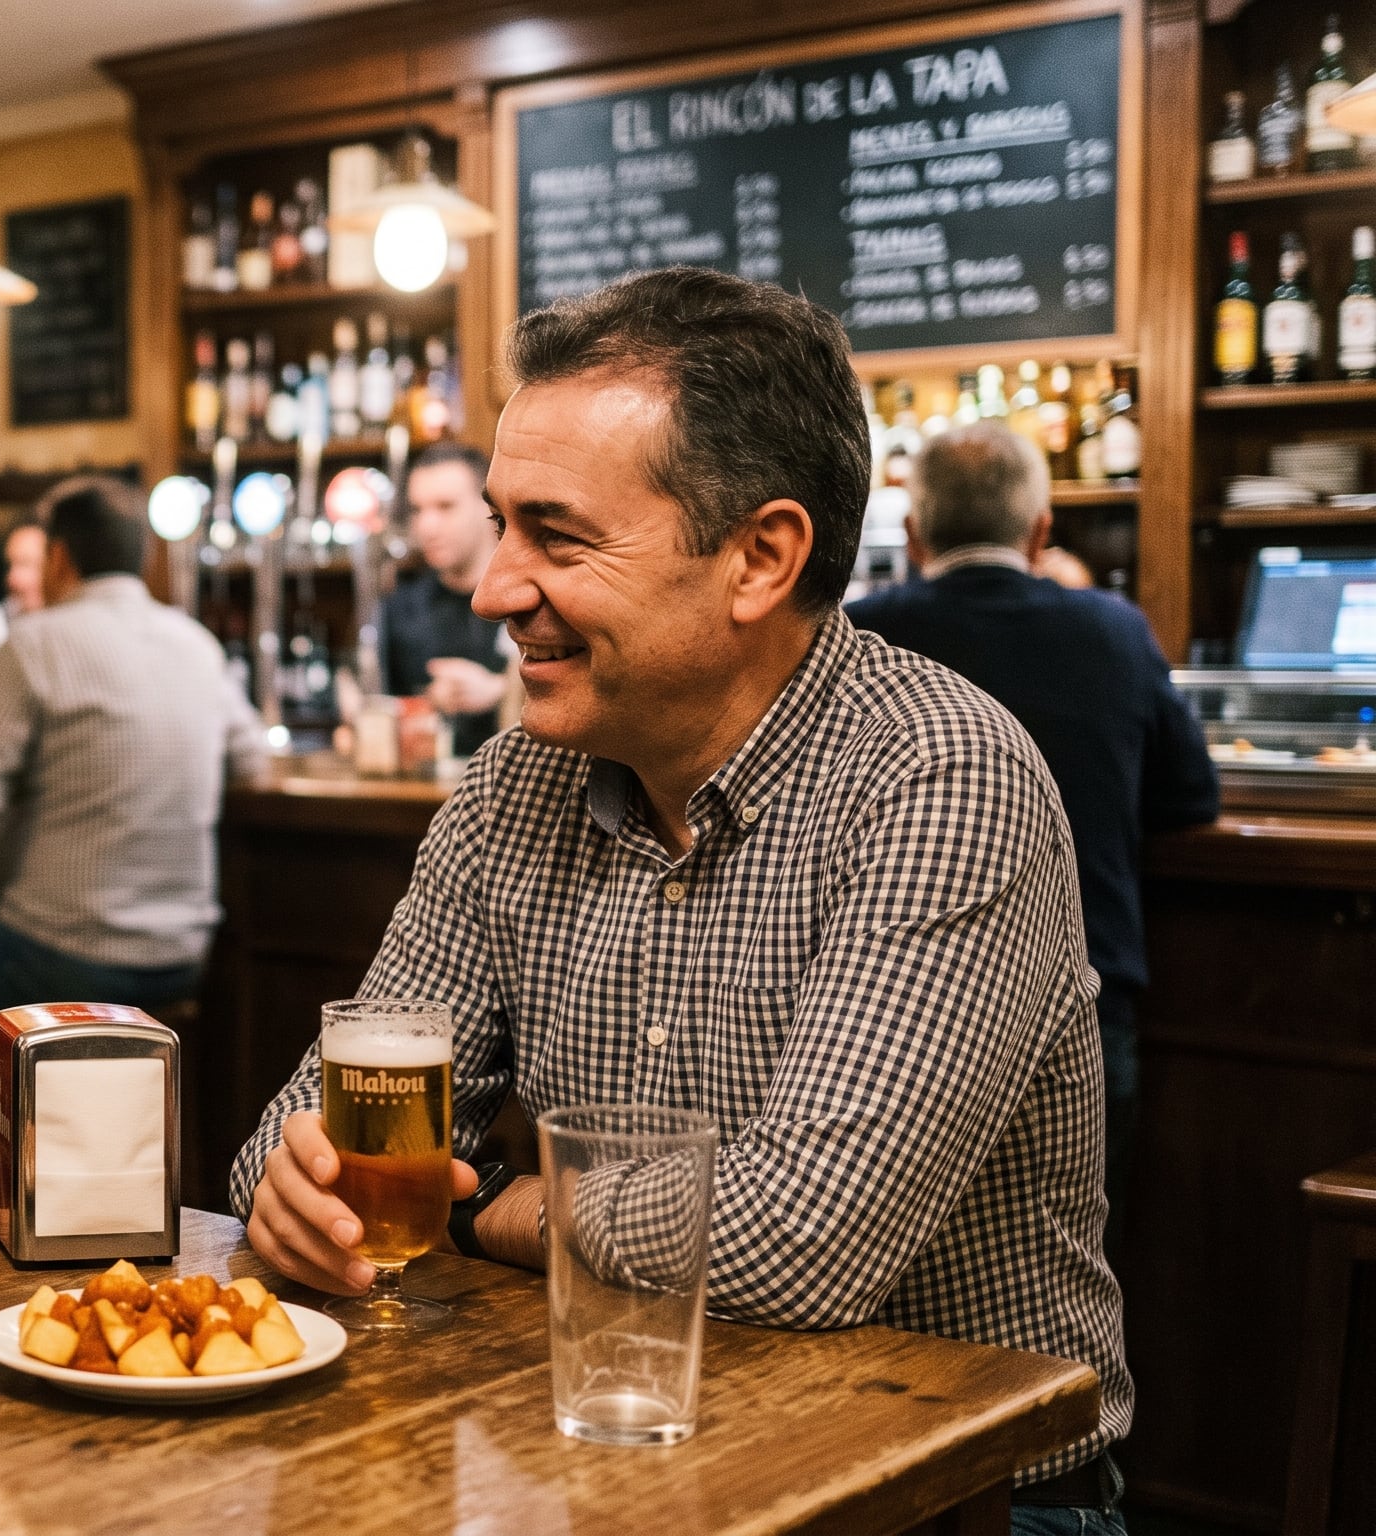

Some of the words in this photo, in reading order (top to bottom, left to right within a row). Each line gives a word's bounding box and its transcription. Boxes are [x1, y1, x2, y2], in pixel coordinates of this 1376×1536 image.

[612, 100, 660, 152] EL
[668, 68, 796, 142] RINCÓN
[802, 77, 847, 124] DE
[849, 68, 899, 116] LA
[904, 45, 1010, 106] TAPA
[340, 1068, 426, 1094] Mahou
